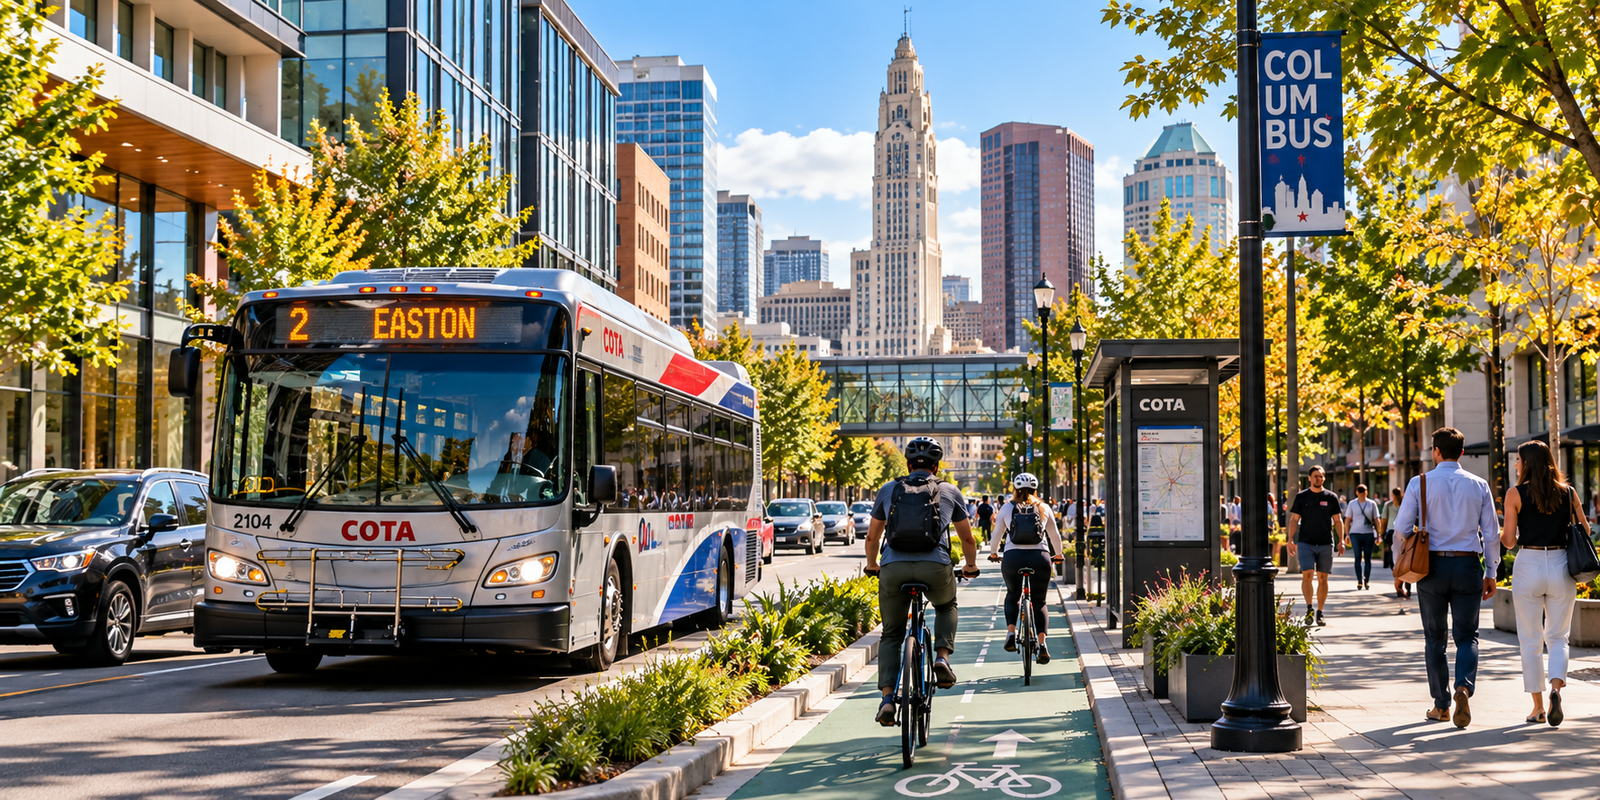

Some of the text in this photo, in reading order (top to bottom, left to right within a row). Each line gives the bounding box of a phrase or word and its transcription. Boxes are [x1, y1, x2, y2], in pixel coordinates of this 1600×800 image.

[1264, 49, 1332, 81] COL
[1265, 83, 1317, 115] UM
[1266, 116, 1332, 149] BUS
[289, 307, 475, 341] 2 EASTON
[603, 326, 624, 358] COTA
[1139, 398, 1186, 411] COTA
[233, 513, 272, 529] 2104
[341, 520, 416, 541] COTA
